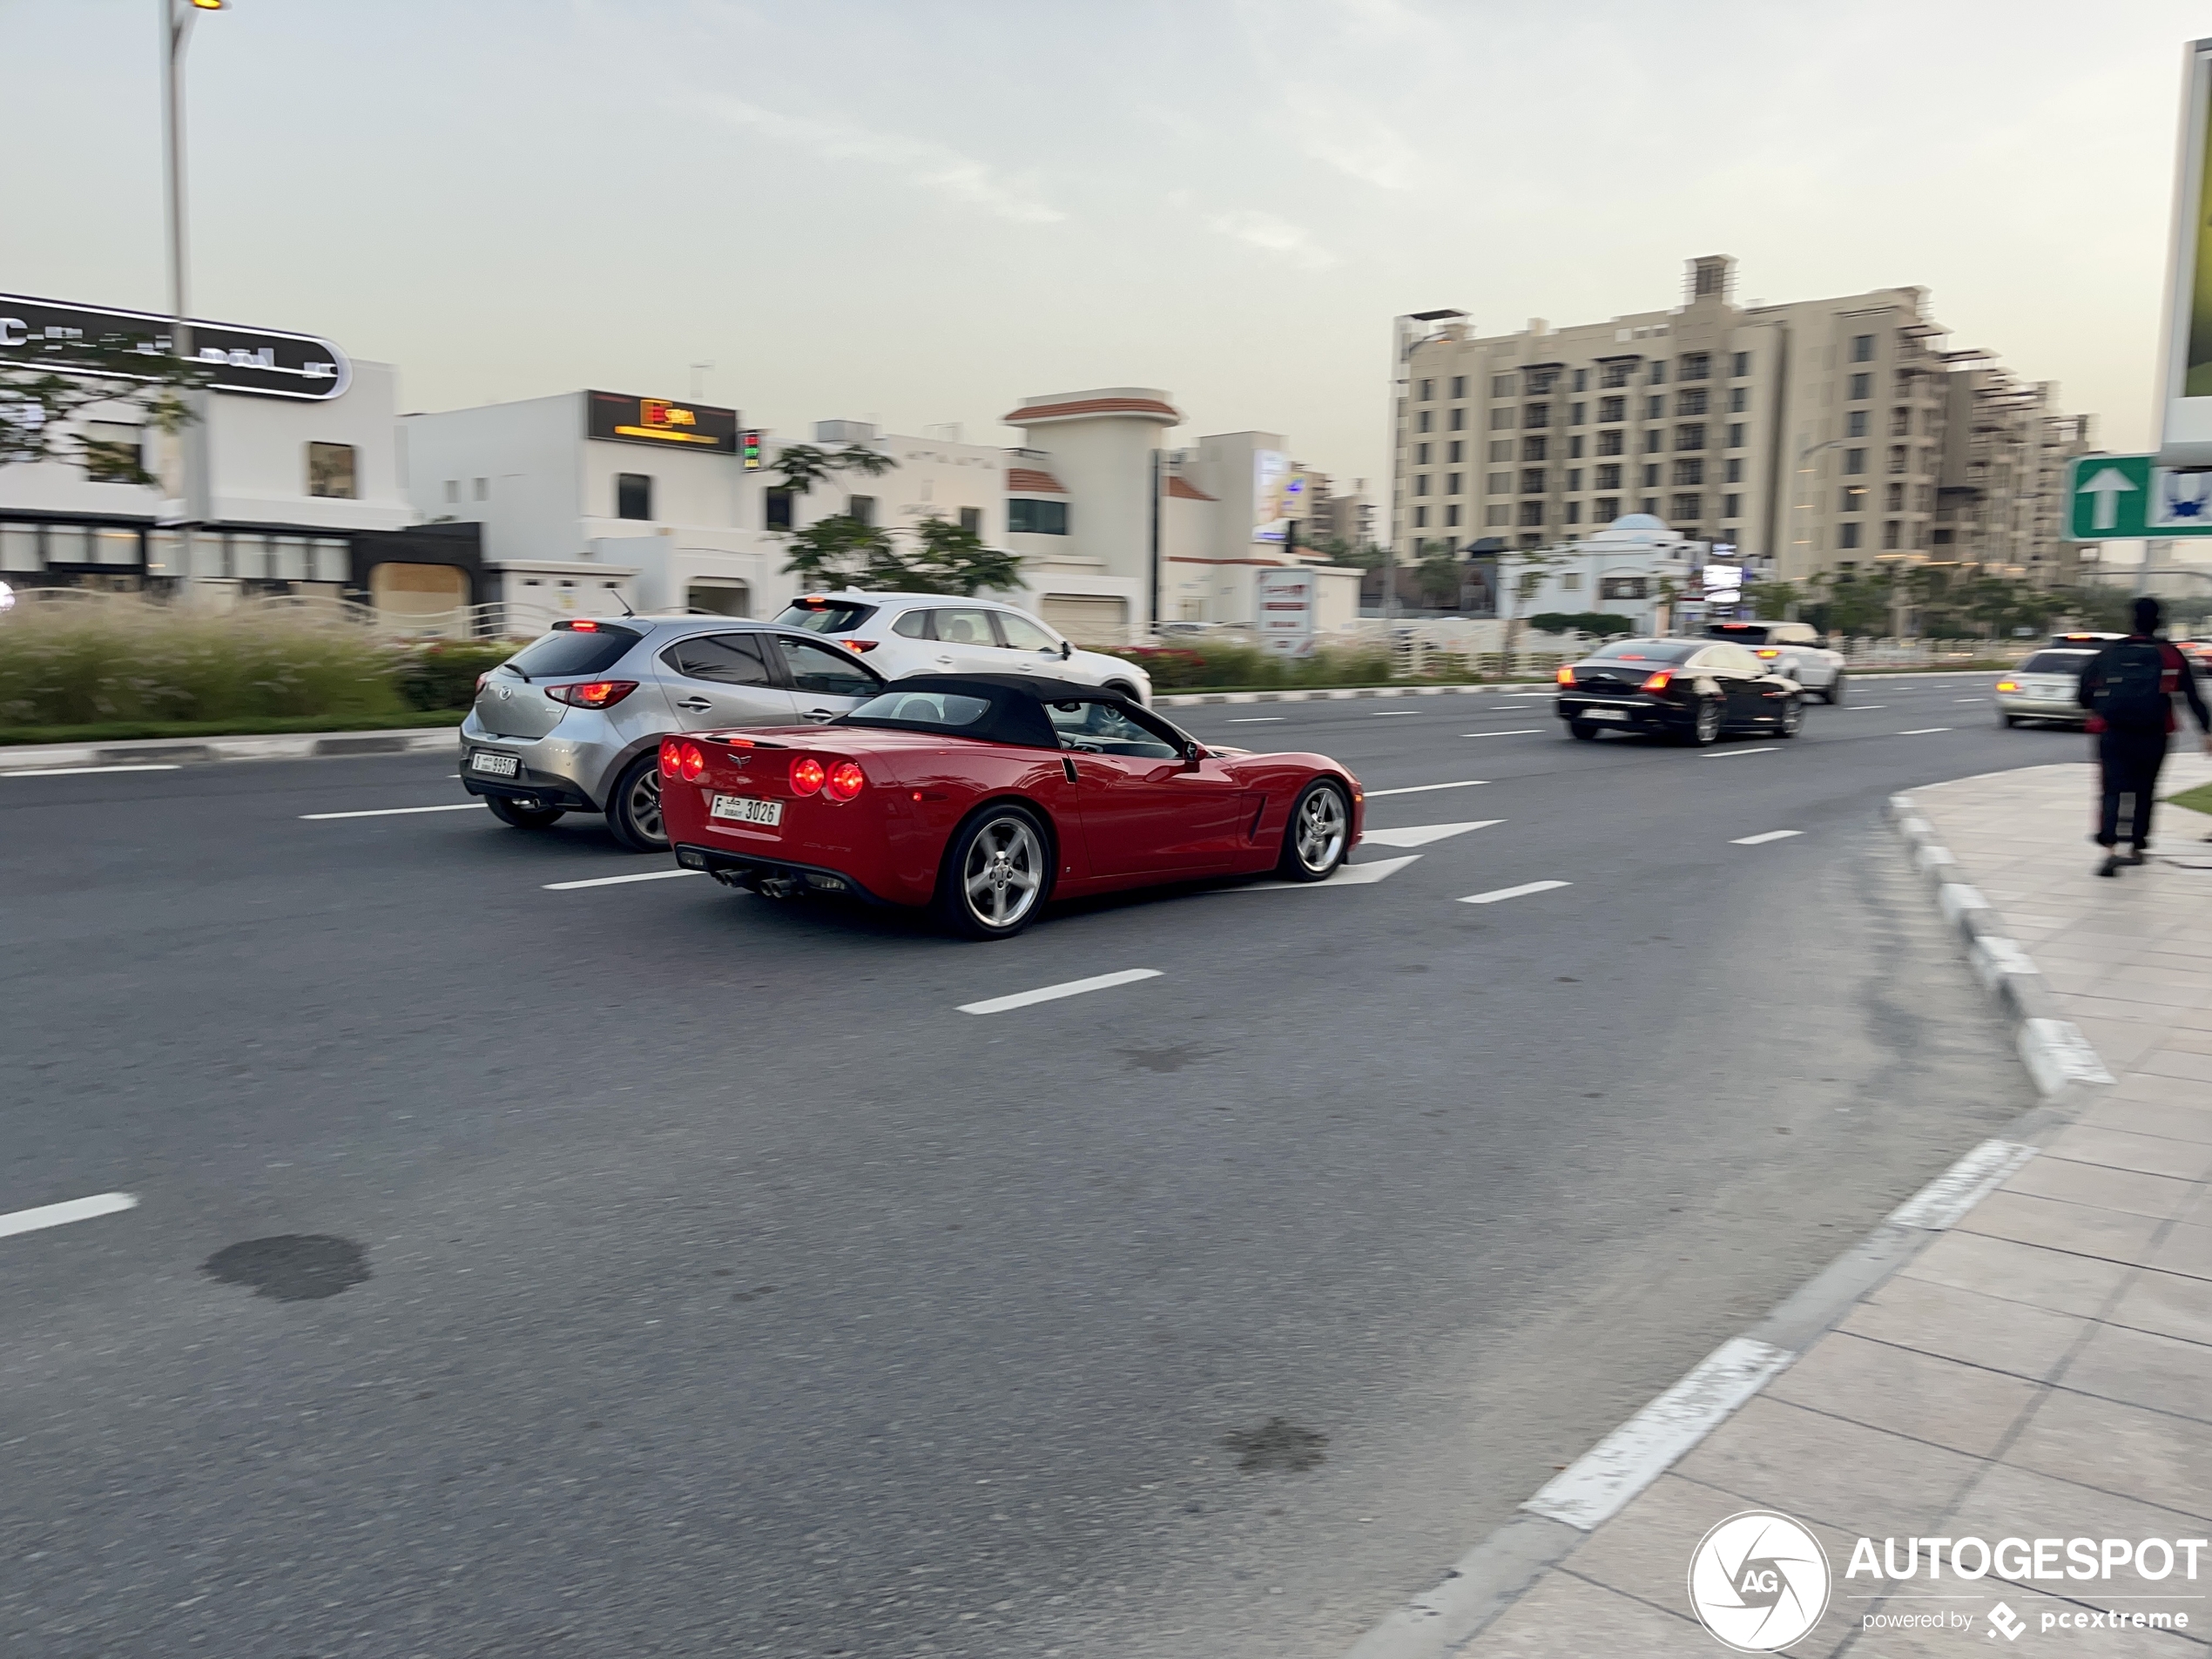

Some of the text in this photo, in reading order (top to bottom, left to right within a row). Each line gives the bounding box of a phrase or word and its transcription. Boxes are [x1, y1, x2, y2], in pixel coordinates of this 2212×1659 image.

[492, 757, 516, 774] 99502
[713, 797, 775, 823] F 3026
